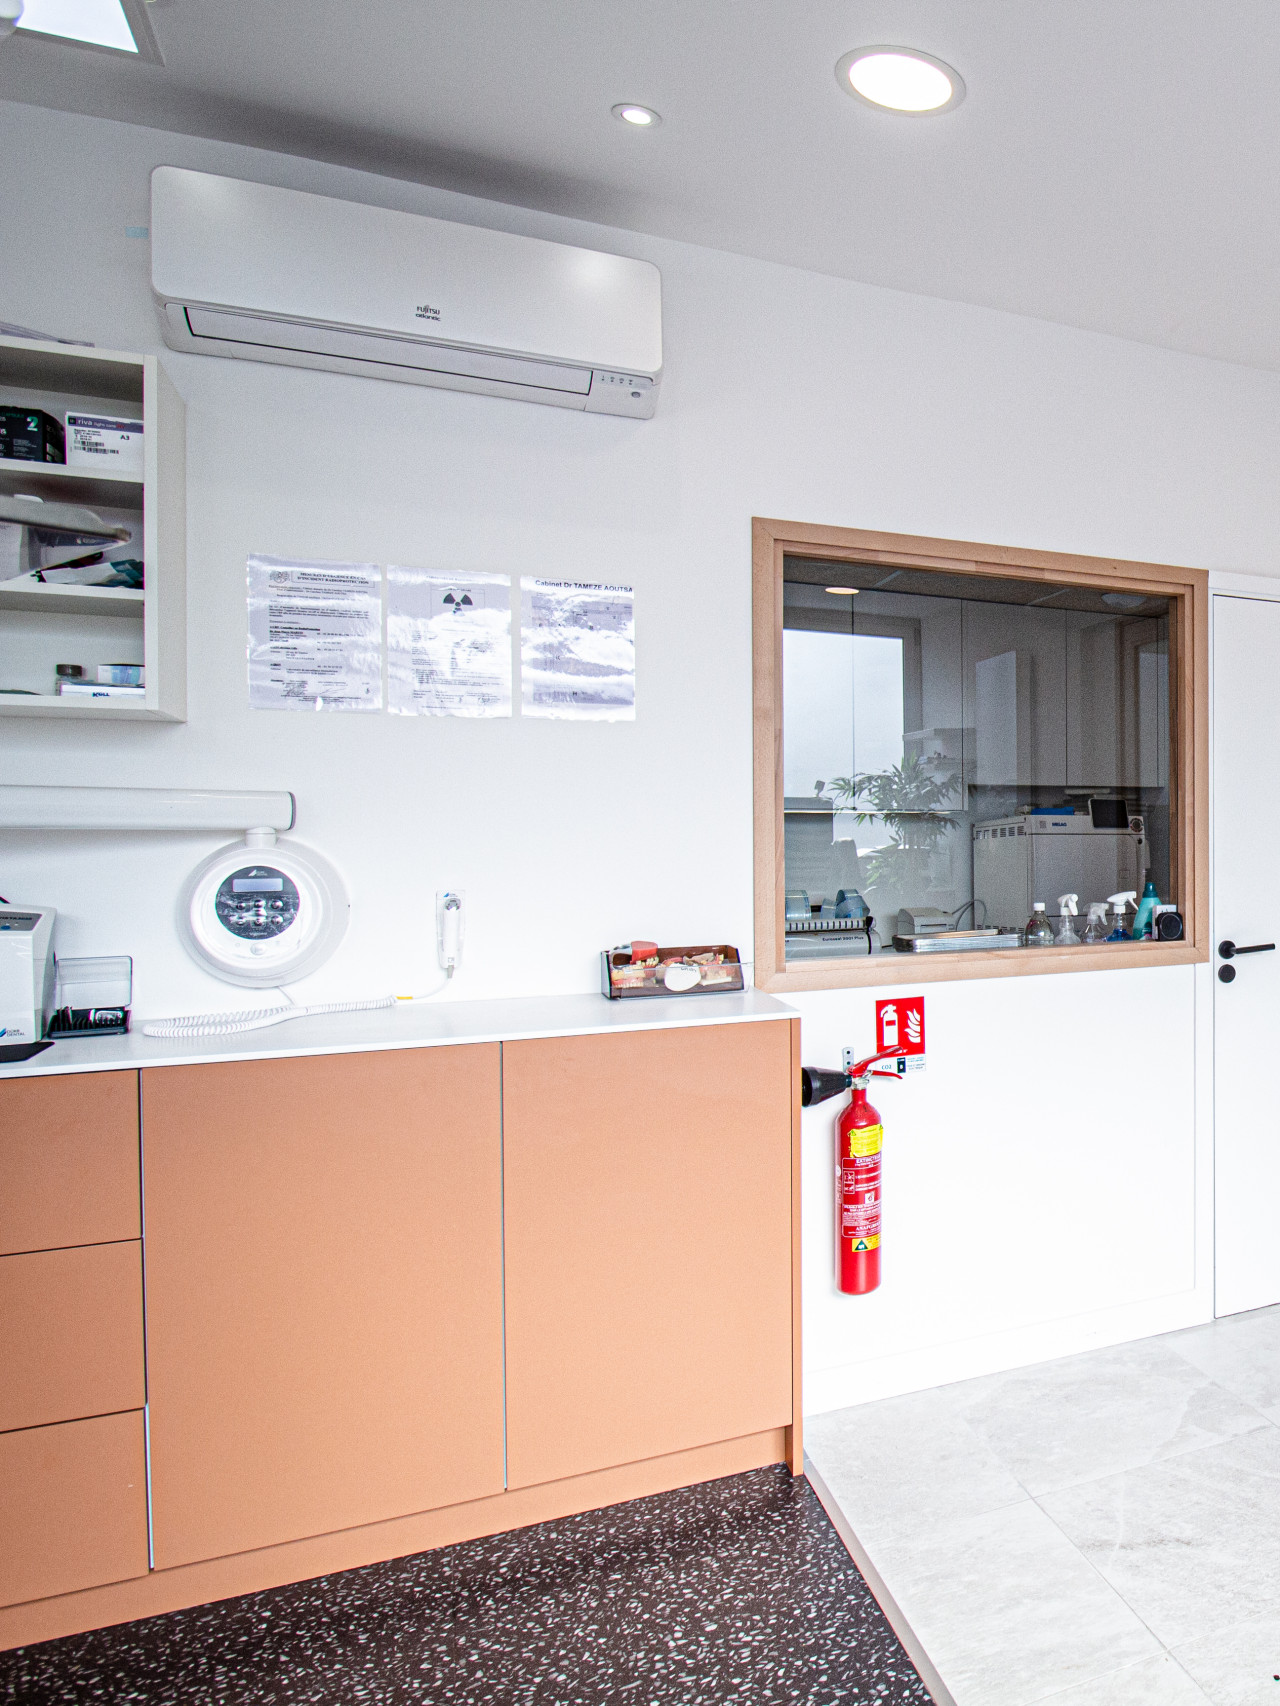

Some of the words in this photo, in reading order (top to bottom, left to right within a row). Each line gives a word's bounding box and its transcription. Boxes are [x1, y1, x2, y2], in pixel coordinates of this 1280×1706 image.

[416, 304, 441, 315] FUJITSU
[26, 416, 39, 432] 2
[77, 418, 93, 426] riva
[535, 579, 562, 588] Cabinet
[574, 582, 602, 591] TAMEZE
